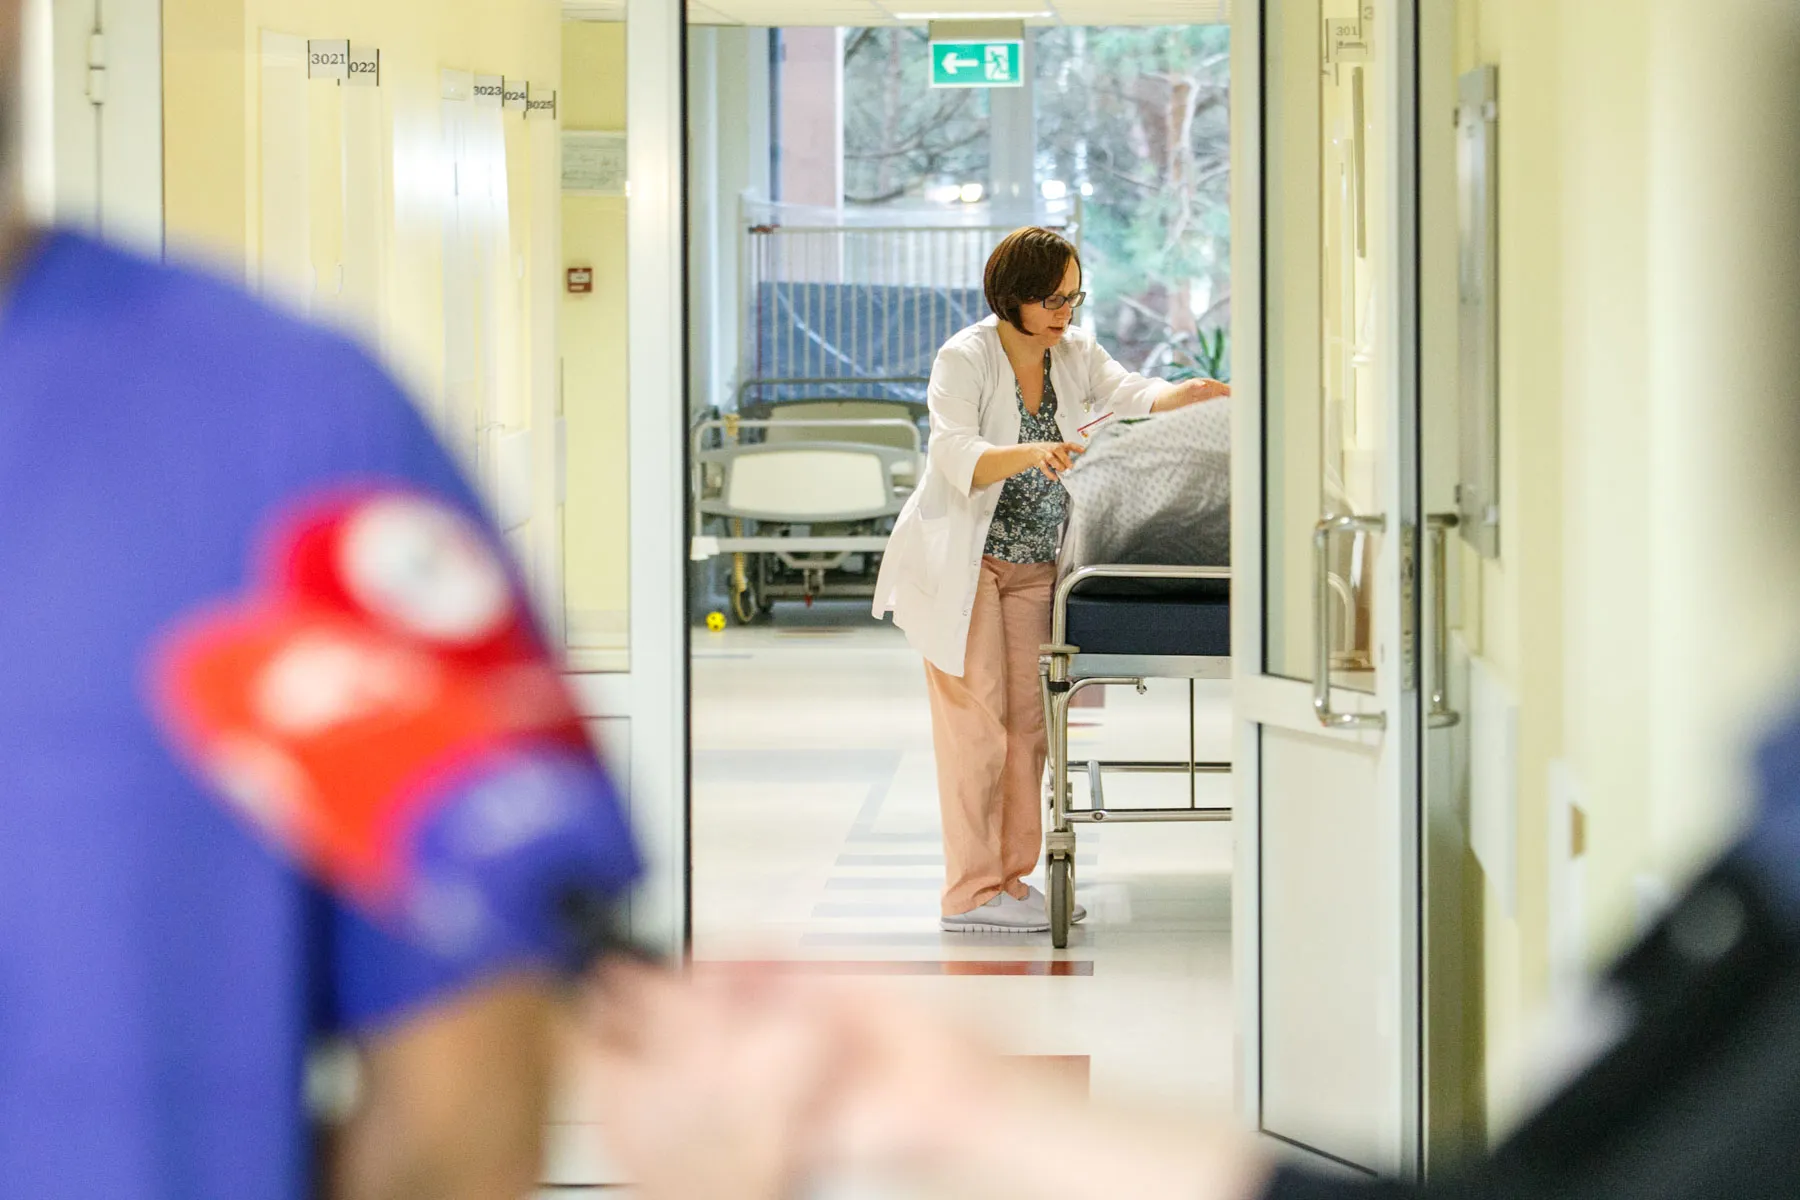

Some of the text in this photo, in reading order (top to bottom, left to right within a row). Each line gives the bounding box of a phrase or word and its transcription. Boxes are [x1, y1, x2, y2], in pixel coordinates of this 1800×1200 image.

[1335, 26, 1360, 36] 301
[311, 53, 346, 65] 3021
[350, 62, 377, 73] 022
[474, 86, 503, 96] 3023
[504, 91, 526, 101] 024
